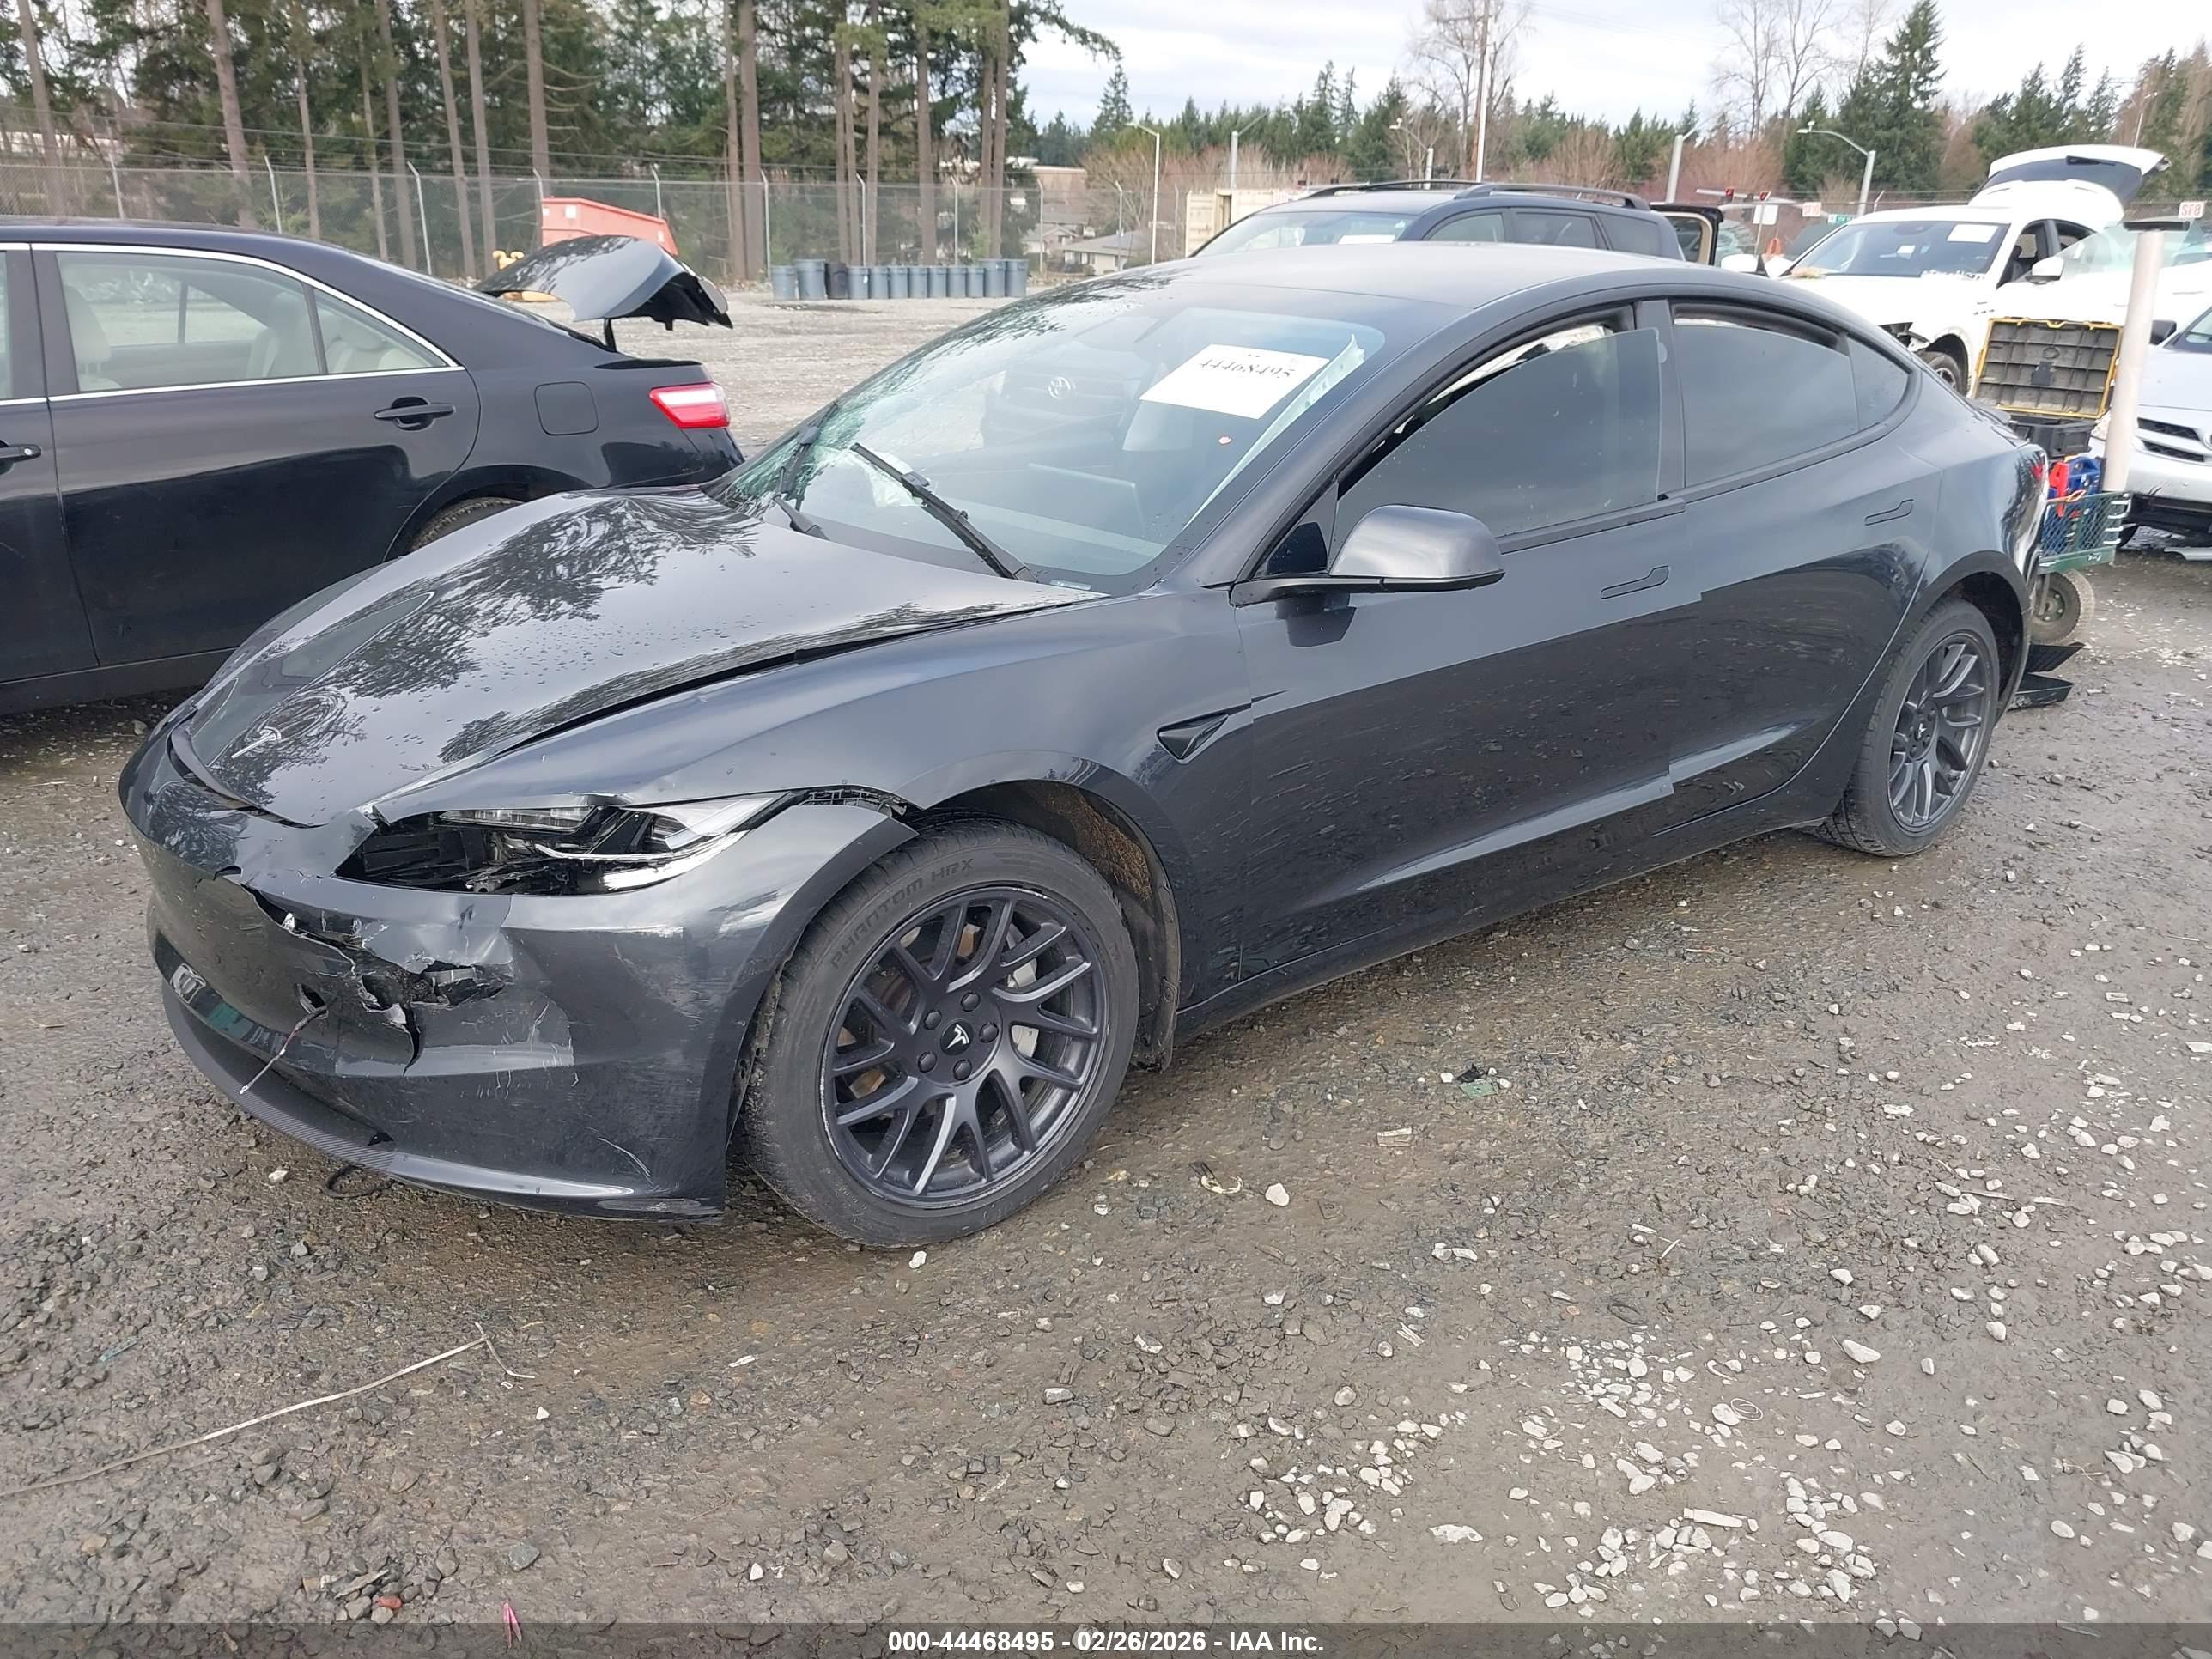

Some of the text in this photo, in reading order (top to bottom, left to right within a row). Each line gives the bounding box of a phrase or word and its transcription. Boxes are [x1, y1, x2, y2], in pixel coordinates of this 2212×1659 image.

[2182, 204, 2202, 216] SF8
[832, 859, 974, 968] PHANTOM HRX
